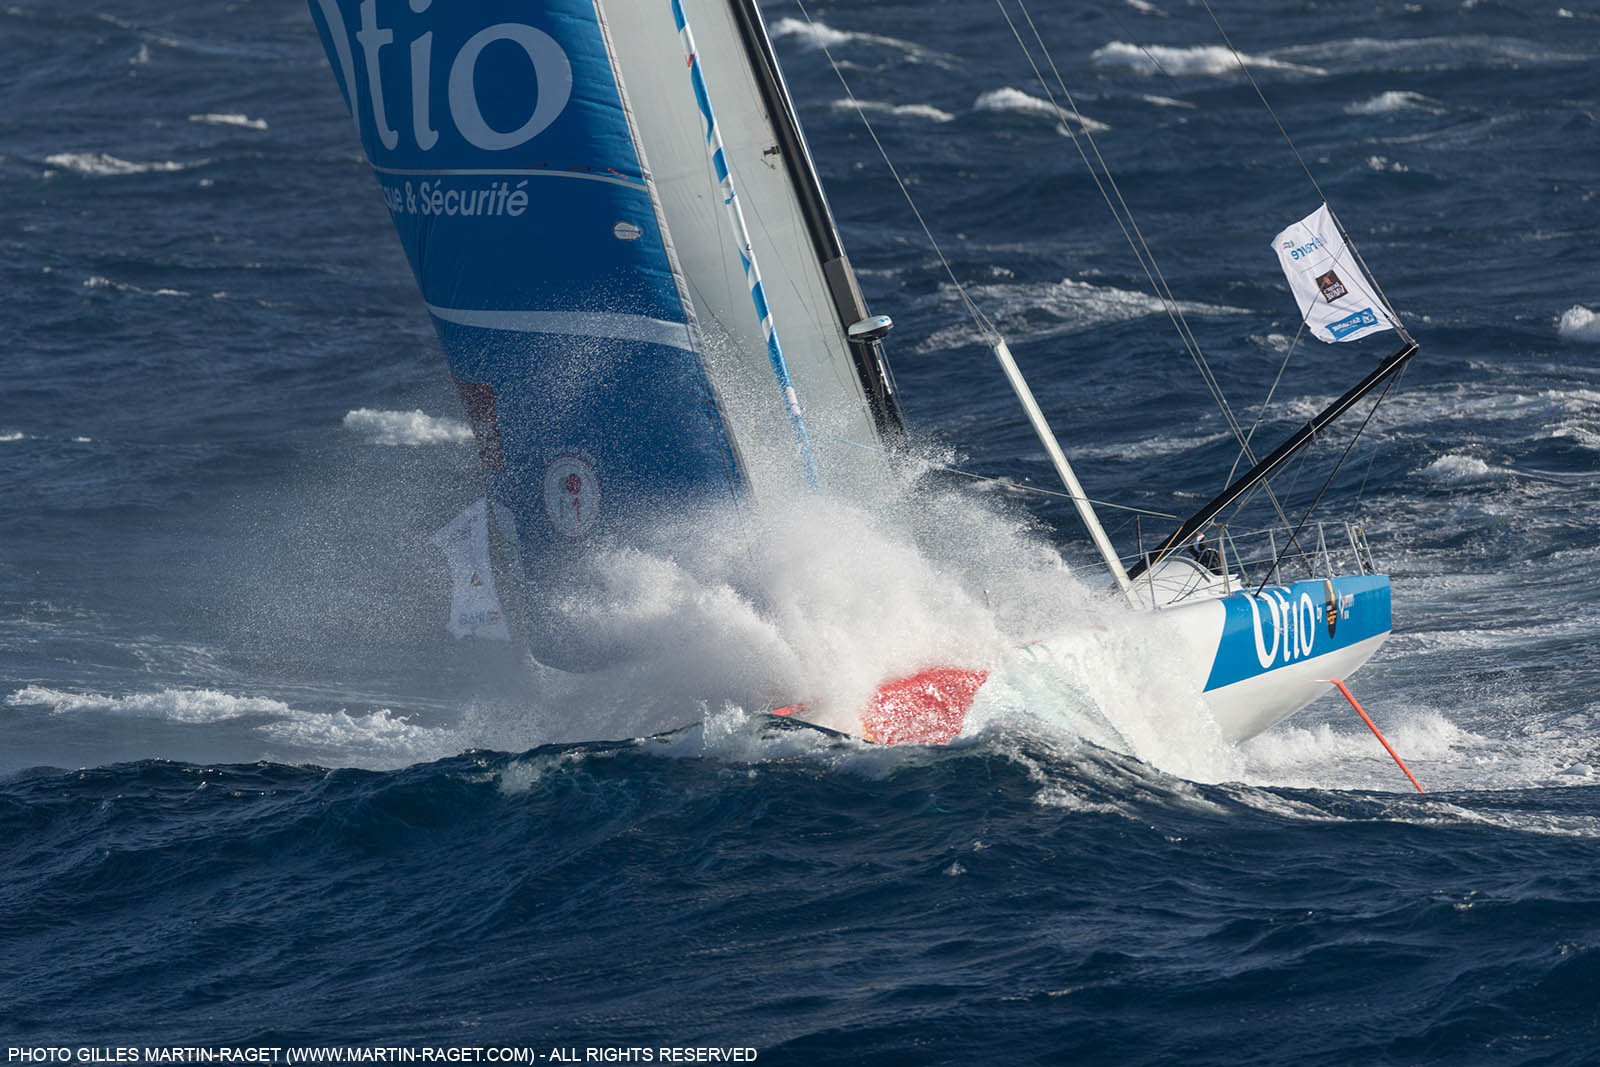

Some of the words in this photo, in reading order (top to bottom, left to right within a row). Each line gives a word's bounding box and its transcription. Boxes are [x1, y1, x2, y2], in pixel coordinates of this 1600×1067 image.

[405, 180, 418, 215] &
[420, 179, 529, 217] Sécurité
[1243, 586, 1315, 668] Otio
